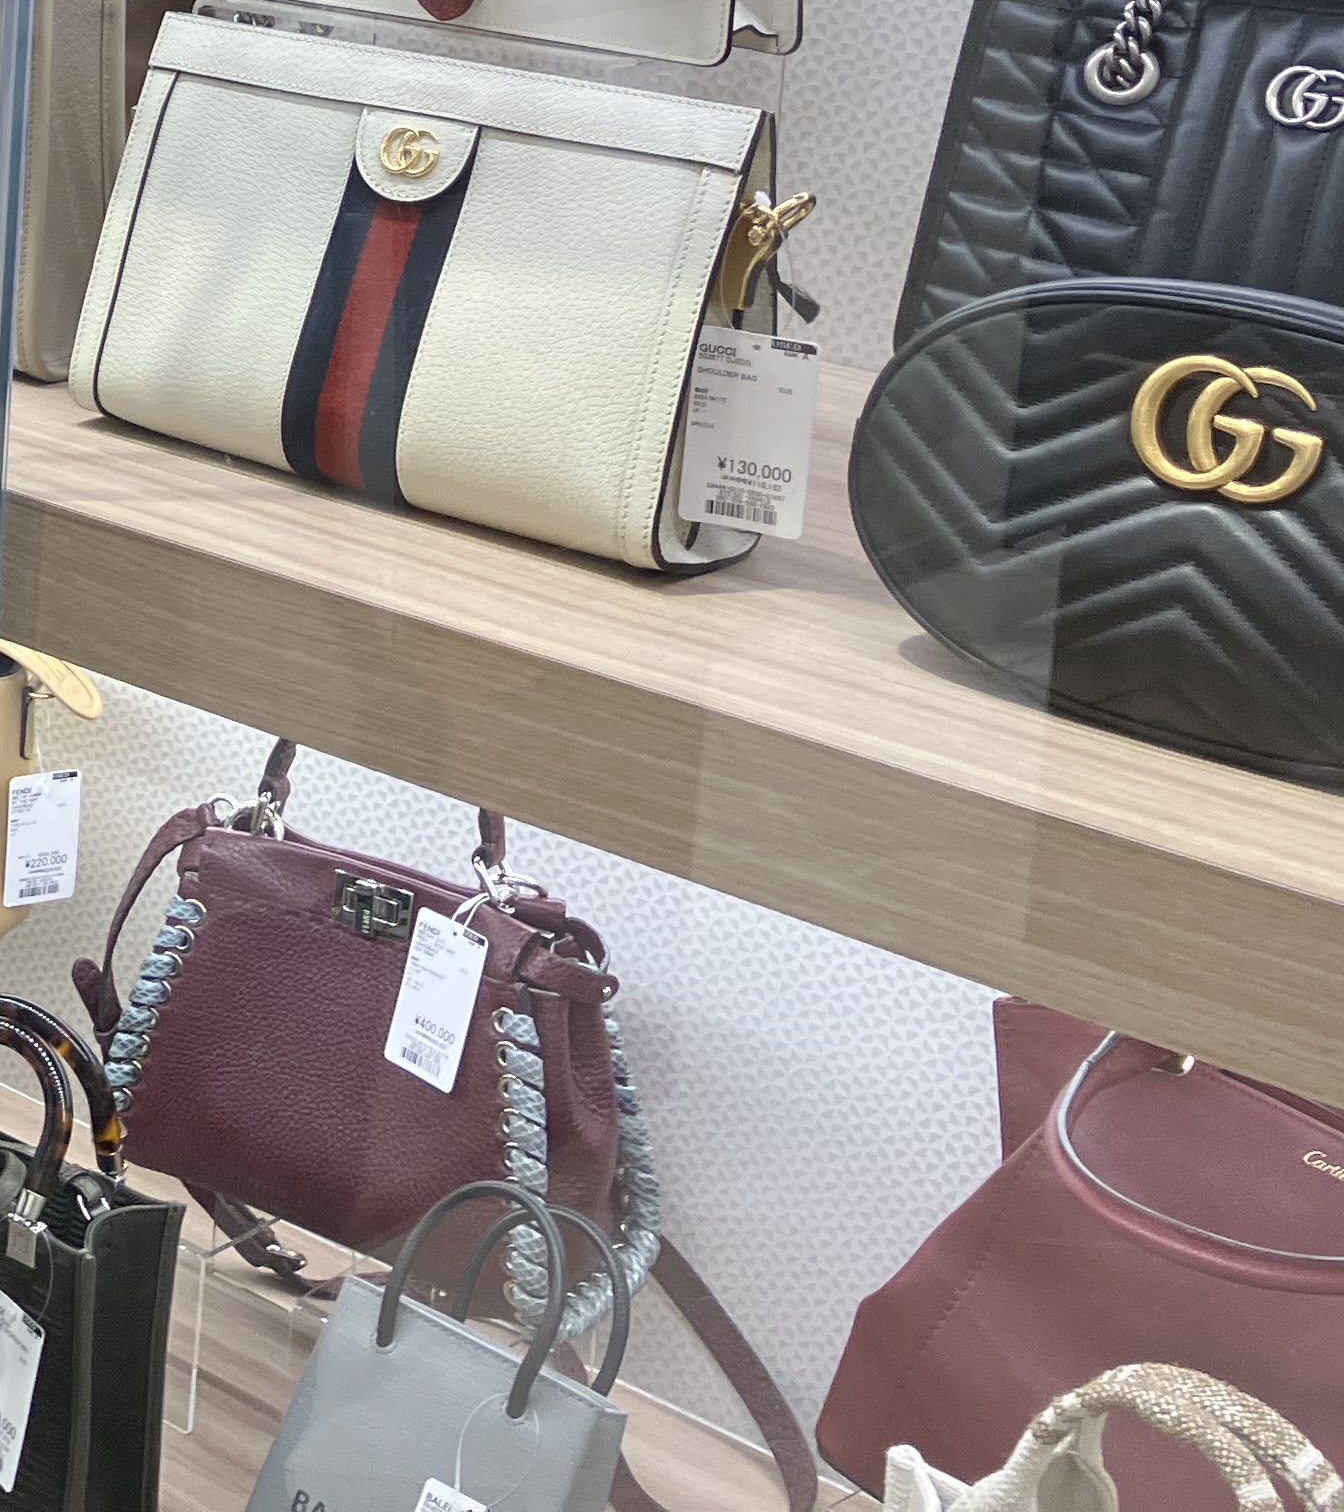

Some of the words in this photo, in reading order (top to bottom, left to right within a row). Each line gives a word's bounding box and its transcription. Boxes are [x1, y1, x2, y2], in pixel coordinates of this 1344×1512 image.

[699, 343, 737, 357] GUCCI
[717, 455, 792, 483] ¥130,000
[25, 854, 67, 868] ¥220,000
[414, 1014, 456, 1045] ¥400,000
